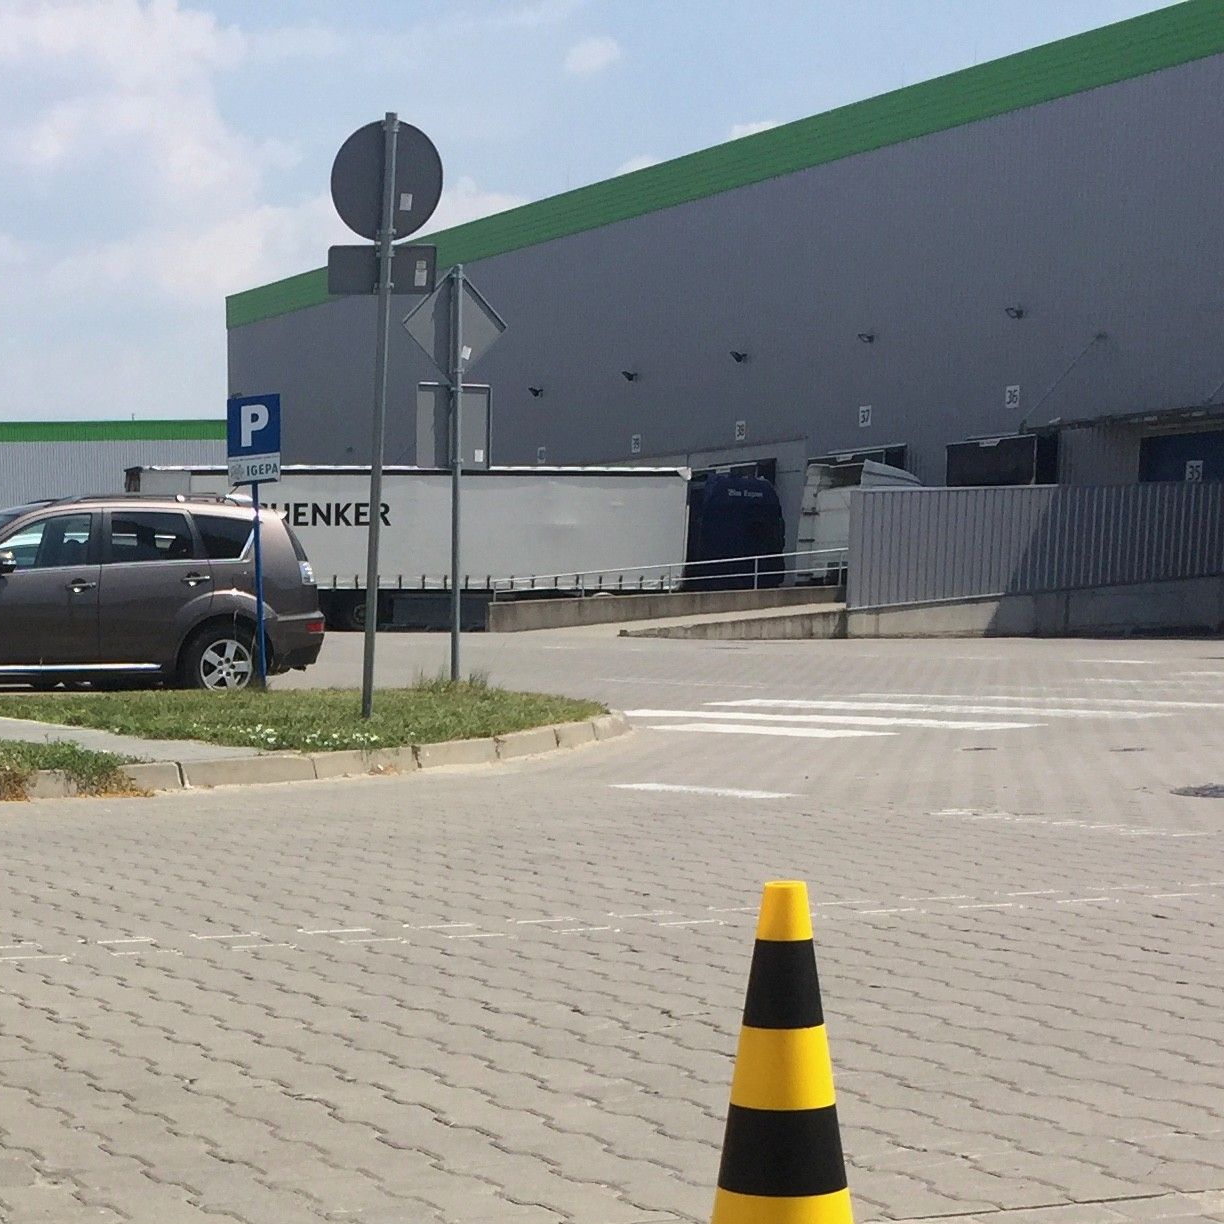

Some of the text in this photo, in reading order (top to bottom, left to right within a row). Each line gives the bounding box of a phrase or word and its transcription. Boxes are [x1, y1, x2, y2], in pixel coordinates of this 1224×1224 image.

[1006, 388, 1019, 405] 36
[859, 409, 871, 424] 37
[240, 403, 269, 448] P
[246, 463, 278, 477] IGEPA
[1188, 464, 1202, 480] 35
